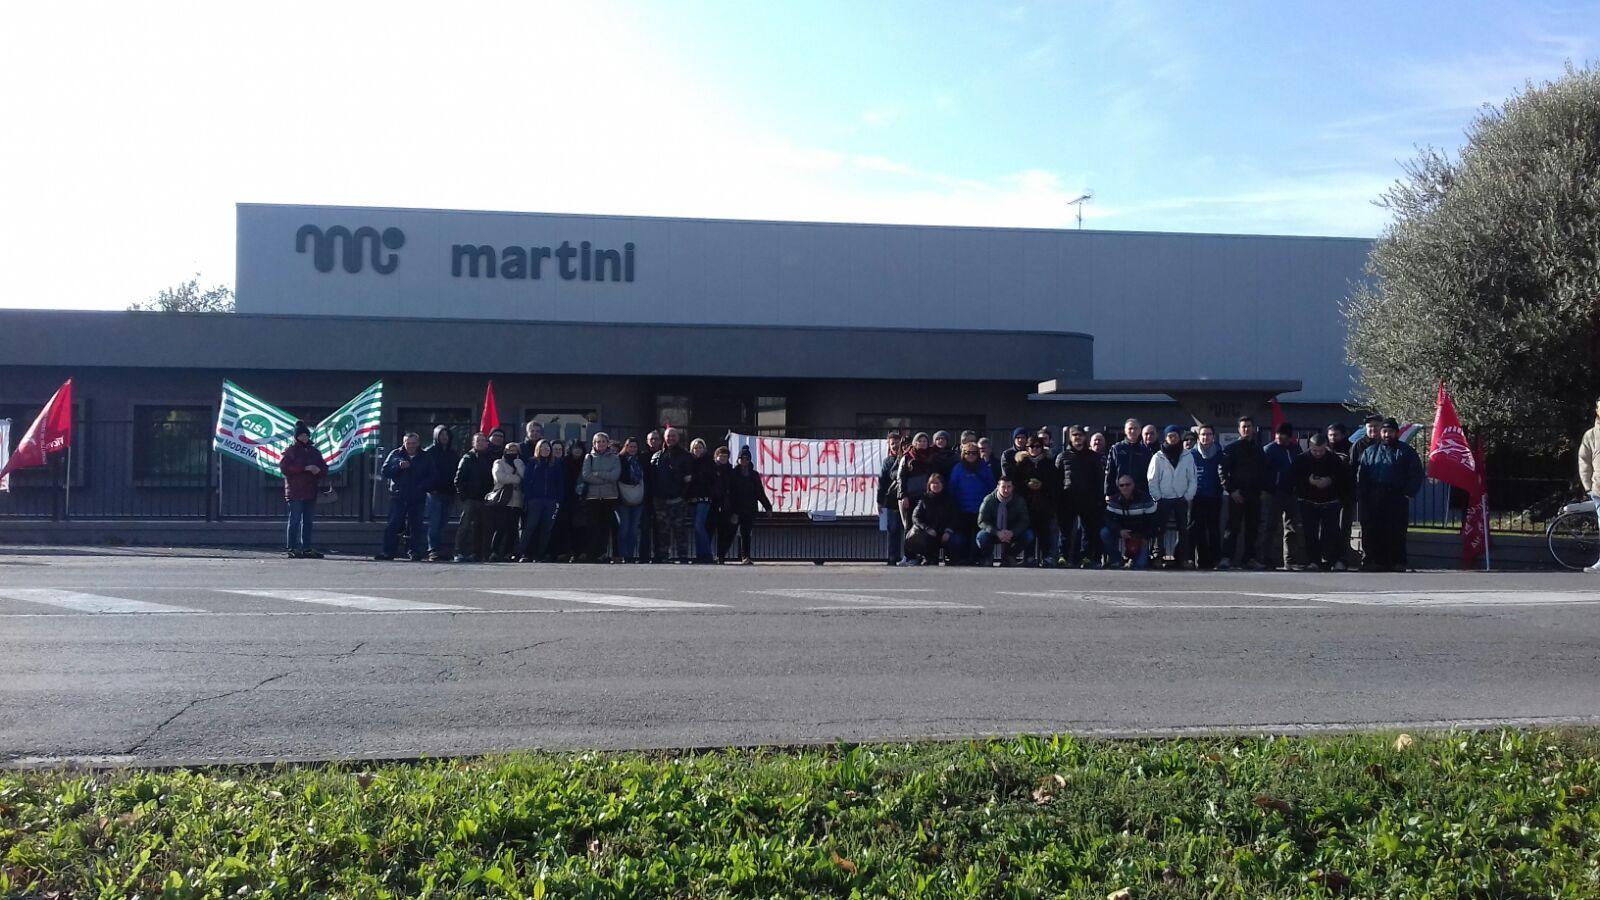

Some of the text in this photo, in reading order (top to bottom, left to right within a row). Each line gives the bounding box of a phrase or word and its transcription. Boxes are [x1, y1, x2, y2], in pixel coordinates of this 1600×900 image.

[451, 240, 636, 282] martini
[241, 418, 267, 437] CISL
[224, 439, 258, 459] MODENA
[759, 438, 856, 466] NO AI
[776, 495, 801, 511] TI
